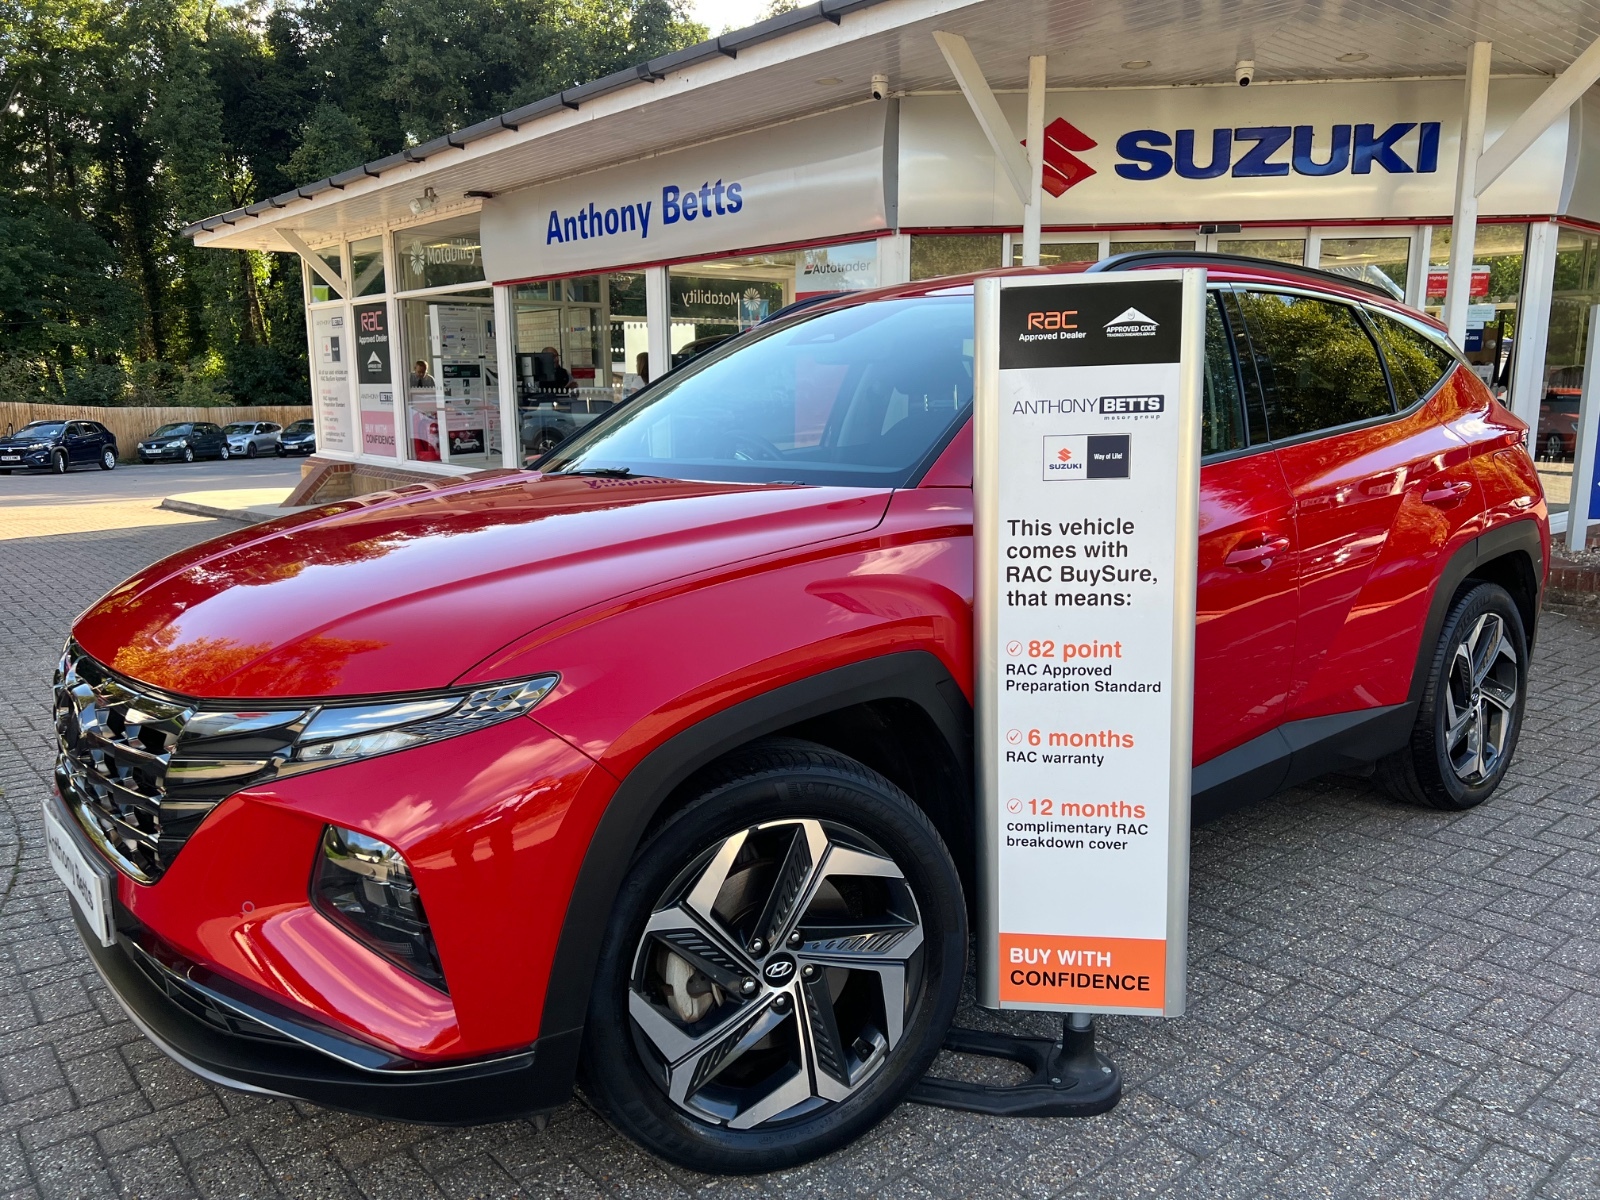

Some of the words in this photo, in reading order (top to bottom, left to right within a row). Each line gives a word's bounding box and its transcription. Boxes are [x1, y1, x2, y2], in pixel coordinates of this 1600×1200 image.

[1115, 121, 1442, 180] SUZUKI
[546, 201, 652, 245] Anthony
[662, 178, 743, 225] Betts
[427, 238, 477, 266] Motability
[812, 261, 871, 275] Autotrader
[1027, 310, 1078, 331] RAC
[1106, 325, 1139, 333] APPROVED
[1140, 324, 1157, 332] CODE
[1018, 332, 1057, 342] Approved
[1060, 331, 1086, 340] Dealer
[1012, 397, 1098, 415] ANTHONY
[1103, 396, 1161, 412] BETTS
[366, 434, 395, 446] CONFIDENCE
[1093, 453, 1105, 461] Way
[1007, 519, 1053, 536] This
[1059, 517, 1135, 536] vehicle
[1006, 544, 1077, 559] comes
[1084, 540, 1128, 558] with
[1006, 565, 1053, 583] RAC
[1060, 564, 1158, 587] BuySure,
[1006, 590, 1048, 607] that
[1054, 592, 1132, 607] means:
[1028, 639, 1055, 658] 82
[1063, 639, 1123, 663] point
[1006, 663, 1038, 676] RAC
[1042, 663, 1112, 679] Approved
[1006, 679, 1090, 695] Preparation
[1094, 680, 1162, 693] Standard
[1028, 728, 1041, 747] 6
[1048, 729, 1134, 748] months
[1006, 751, 1038, 763] RAC
[1042, 752, 1105, 768] warranty
[1028, 798, 1054, 816] 12
[1061, 800, 1146, 819] months
[1006, 821, 1112, 838] complimentary
[1116, 823, 1149, 836] RAC
[1006, 835, 1084, 849] breakdown
[1088, 839, 1129, 850] cover
[1009, 947, 1051, 965] BUY
[1057, 949, 1112, 968] WITH
[1010, 969, 1150, 991] CONFIDENCE
